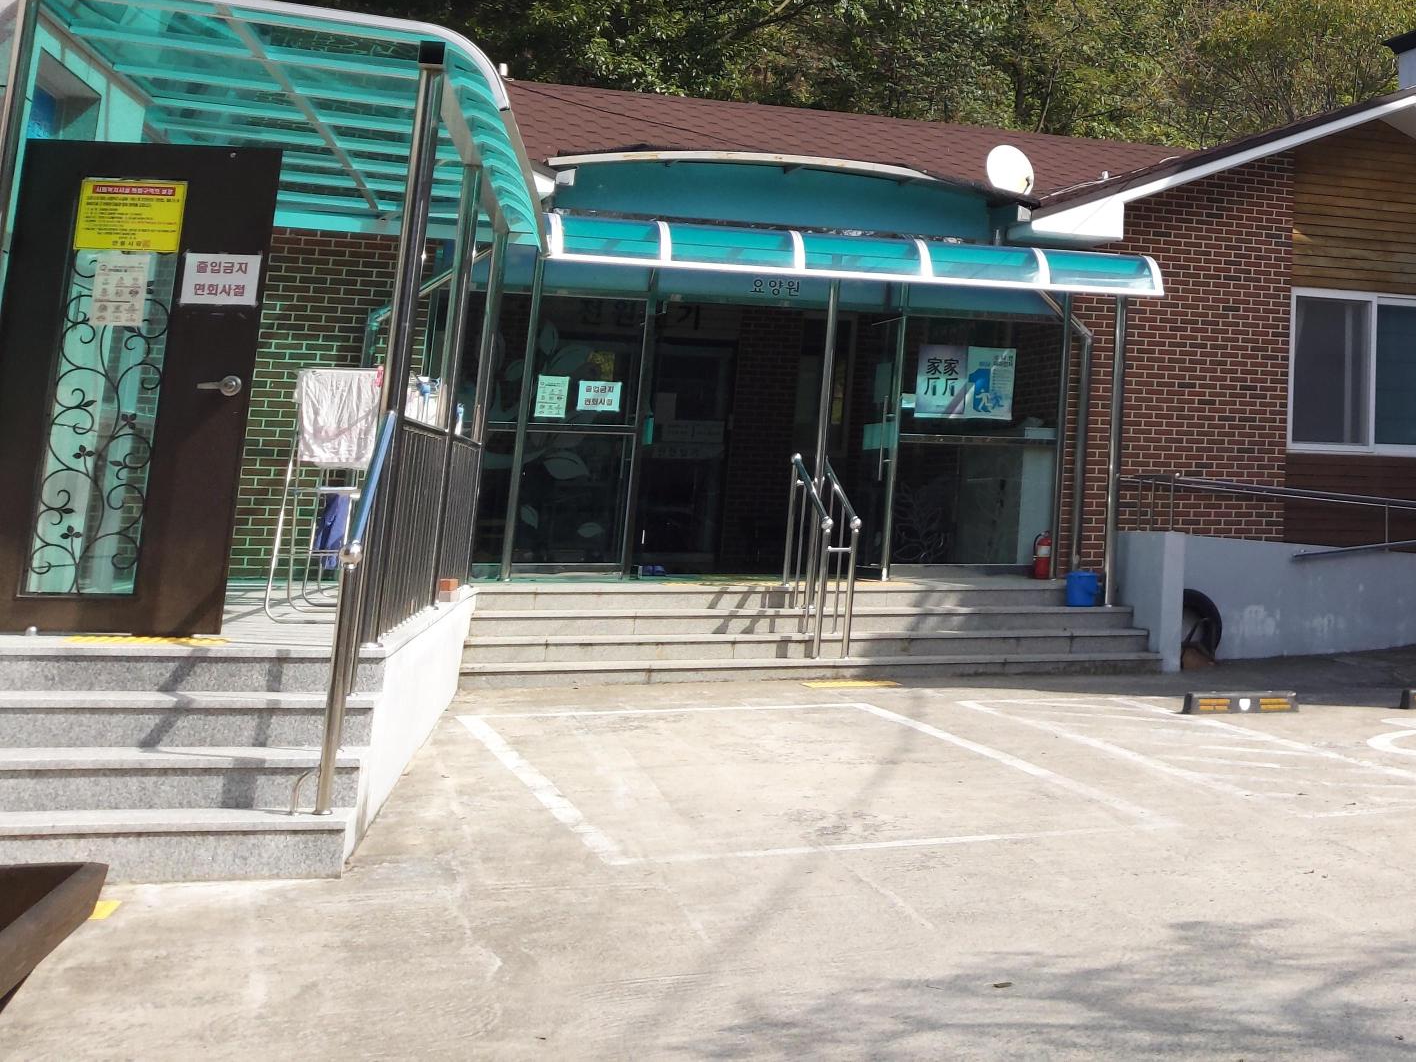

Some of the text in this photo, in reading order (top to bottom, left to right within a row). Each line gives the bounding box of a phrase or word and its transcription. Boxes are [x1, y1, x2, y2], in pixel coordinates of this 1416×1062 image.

[196, 261, 248, 274] 출입금지
[194, 283, 246, 296] 면회사절
[750, 279, 800, 297] 요양원
